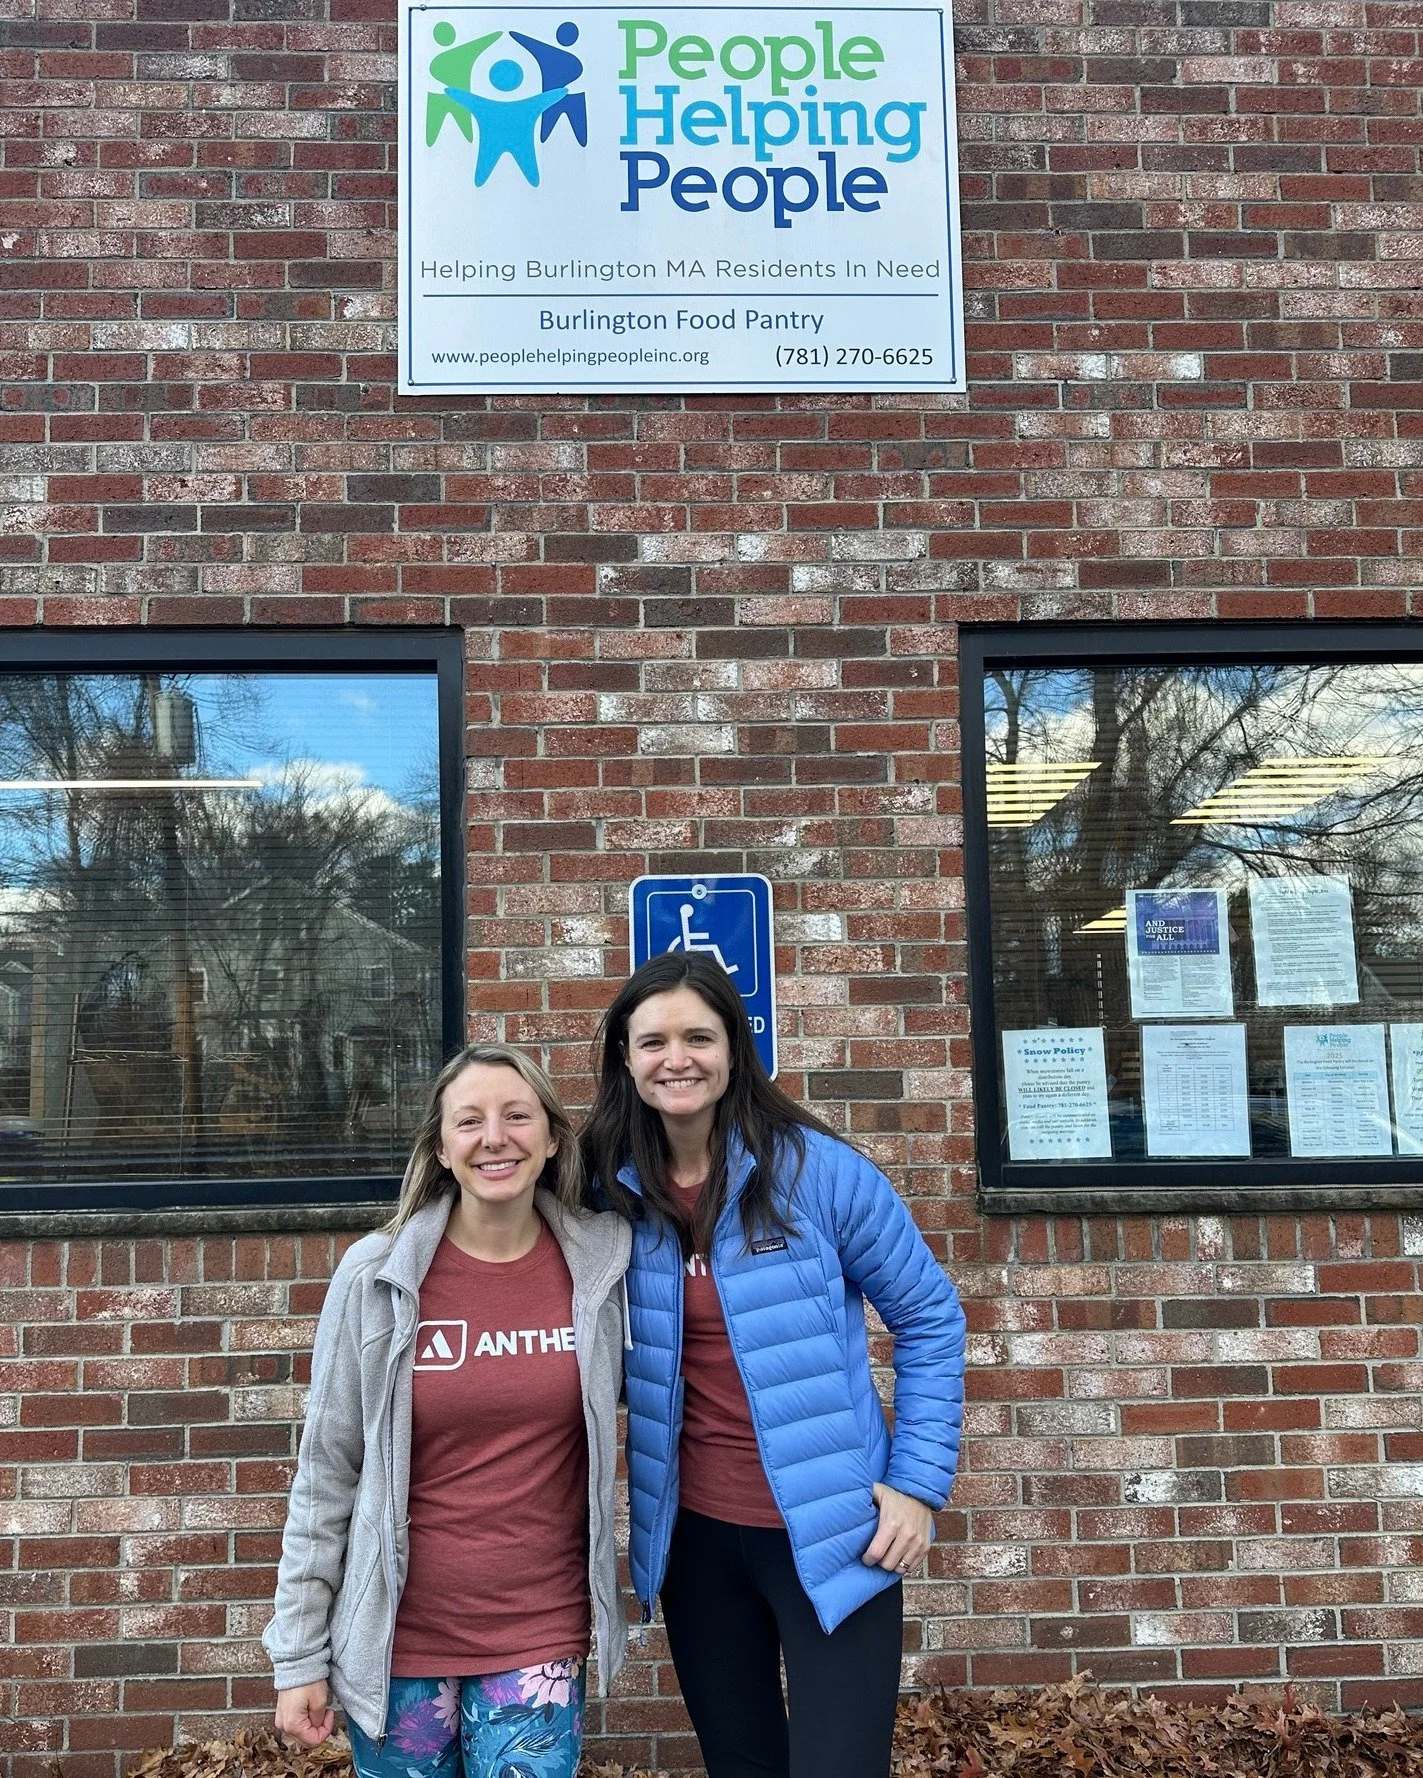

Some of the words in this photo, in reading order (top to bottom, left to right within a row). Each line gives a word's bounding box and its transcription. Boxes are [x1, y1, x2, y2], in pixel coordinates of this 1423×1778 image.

[618, 20, 885, 95] People
[619, 85, 927, 163] Helping
[620, 151, 889, 228] People
[421, 260, 516, 281] Helping
[526, 260, 656, 281] Burlington
[667, 260, 706, 278] MA
[716, 260, 836, 278] Residents
[846, 260, 867, 278] In
[877, 260, 940, 278] Need
[540, 309, 667, 334] Burlington
[677, 309, 736, 330] Food
[746, 309, 824, 334] Pantry
[432, 347, 709, 366] www.peoplehelpingpeopleinc.org
[776, 346, 829, 368] (781)
[836, 347, 933, 366] 270-6625
[1145, 926, 1185, 934] JUSTICE
[748, 1016, 765, 1034] D
[1024, 1048, 1052, 1056] Snow
[1053, 1047, 1086, 1056] Policy
[473, 1326, 576, 1358] ANTHE
